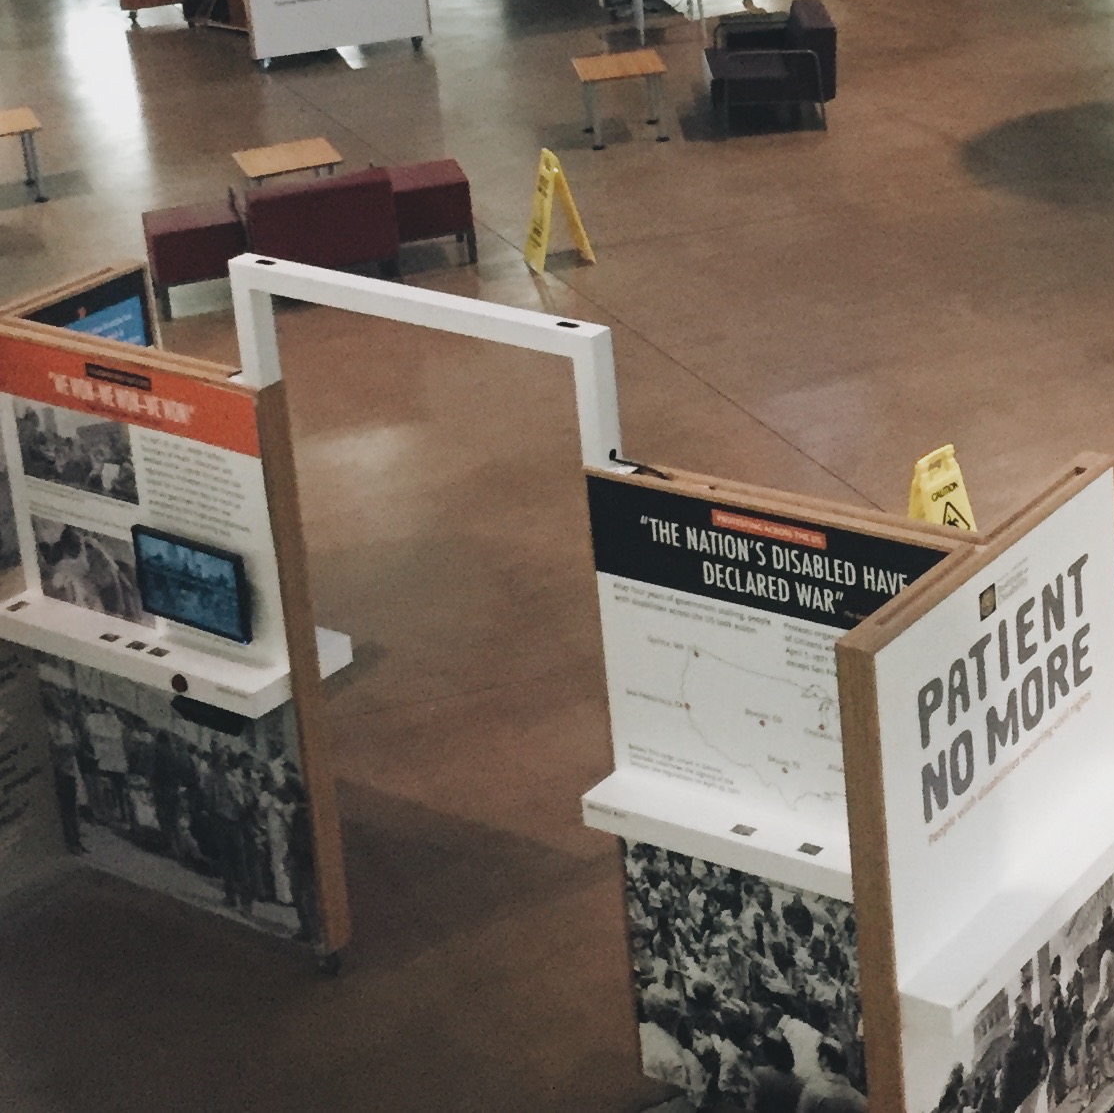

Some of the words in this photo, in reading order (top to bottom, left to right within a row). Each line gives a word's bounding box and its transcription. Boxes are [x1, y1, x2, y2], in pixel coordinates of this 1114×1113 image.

[702, 560, 791, 603] DECLARED
[772, 544, 857, 587] DISABLED
[863, 565, 909, 596] HAVE
[917, 552, 1089, 750] PATIENT
[920, 729, 975, 824] NO
[985, 622, 1093, 766] MORE
